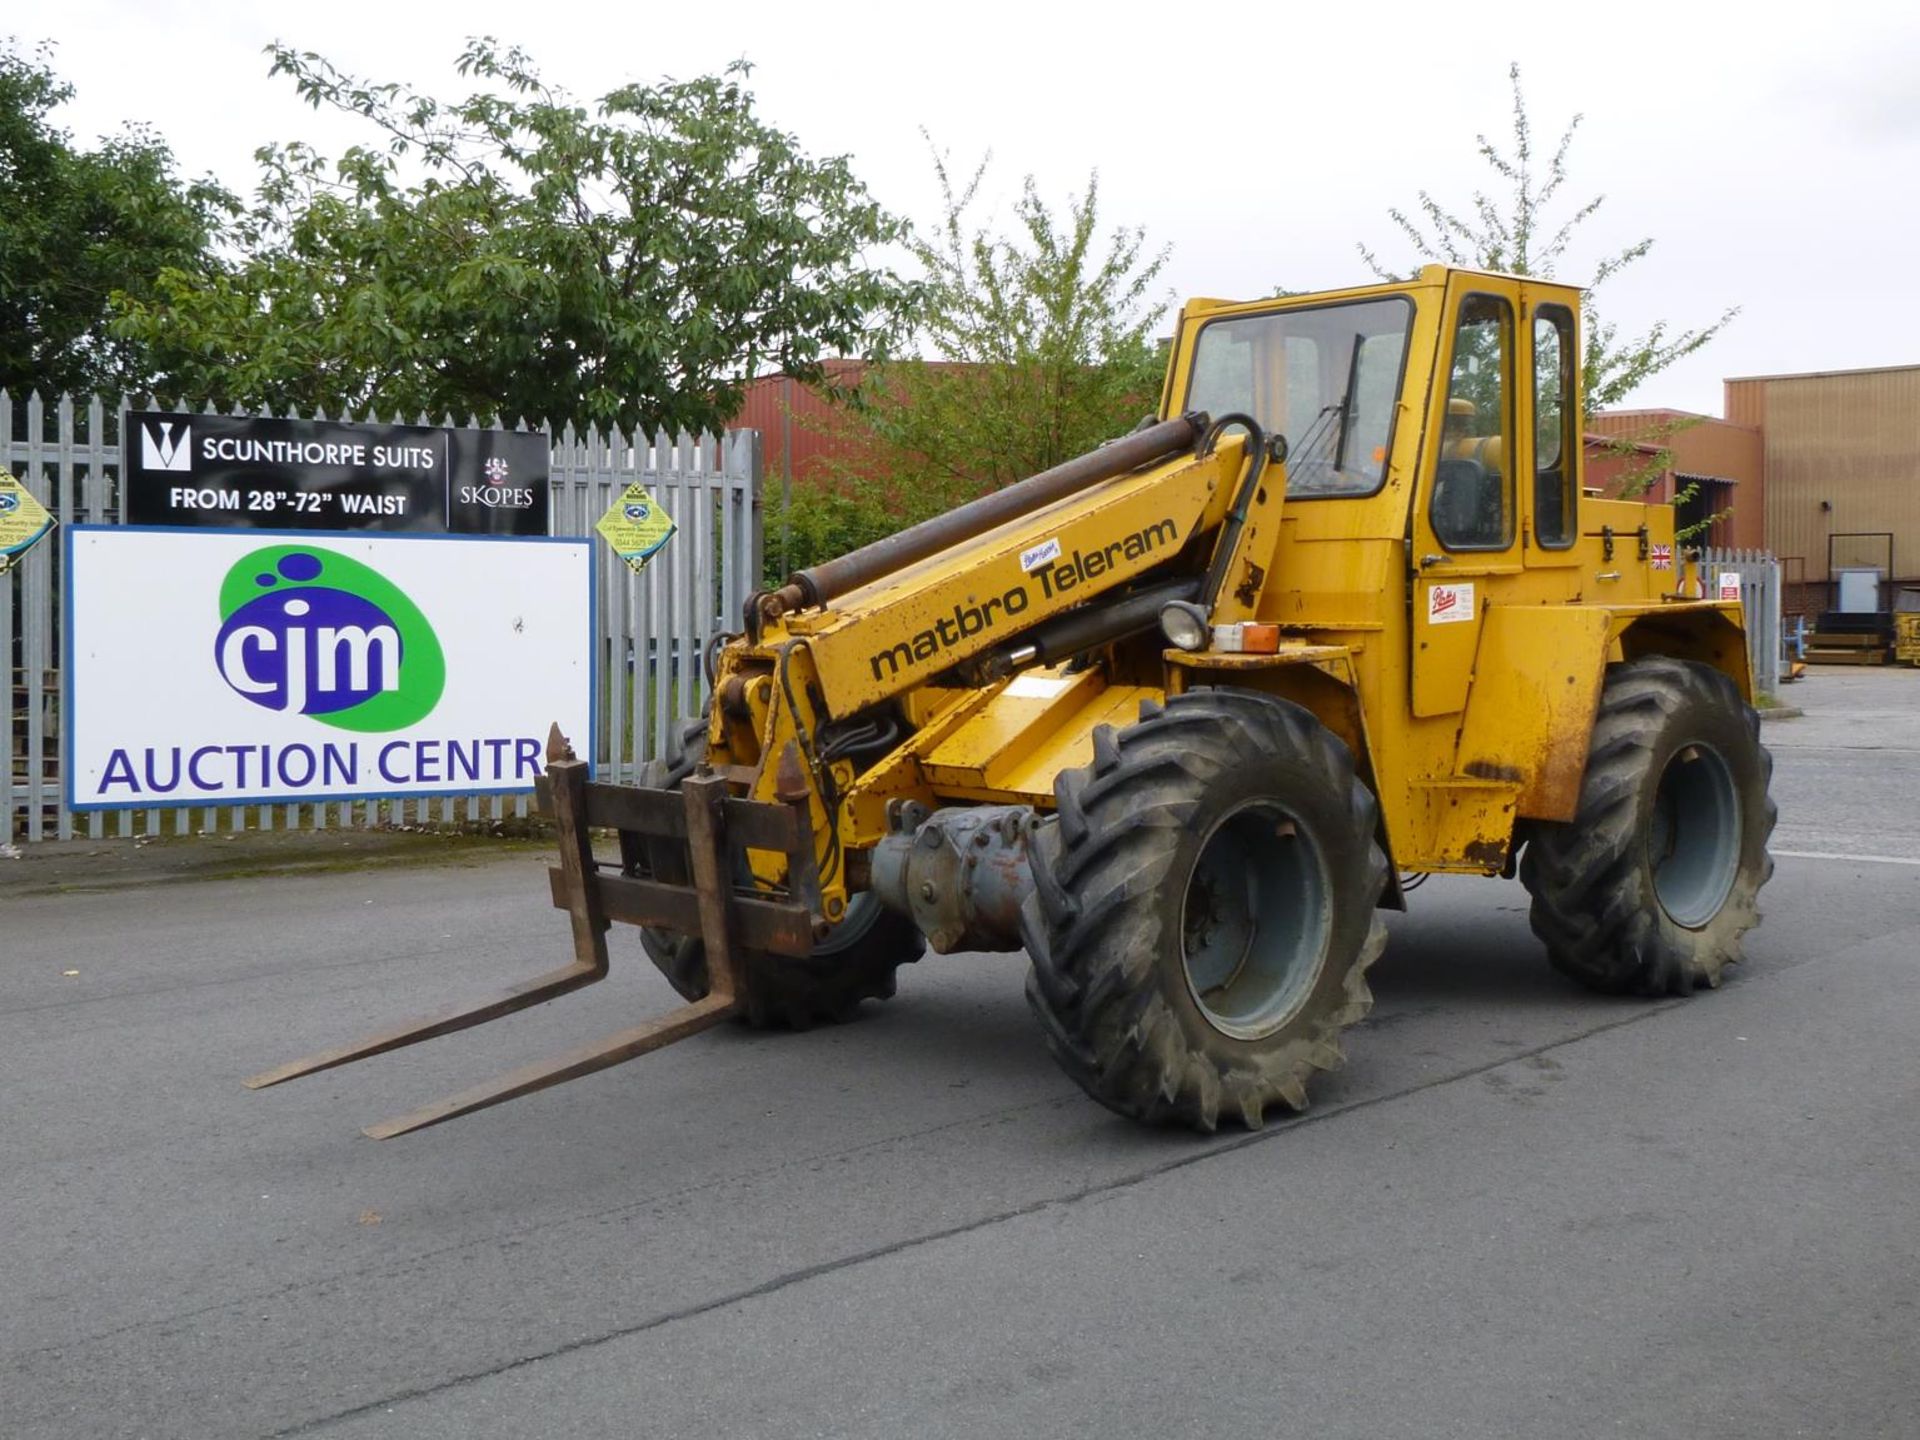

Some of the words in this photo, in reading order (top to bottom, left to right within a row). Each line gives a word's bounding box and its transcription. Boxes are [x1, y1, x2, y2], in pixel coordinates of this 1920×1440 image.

[202, 437, 366, 467] SCUNTHORPE
[372, 445, 434, 470] SUITS
[170, 487, 241, 511] FROM
[340, 493, 406, 515] WAIST
[459, 484, 534, 508] SKOPES
[869, 584, 1029, 682] matbro
[1030, 517, 1178, 600] Teleram
[222, 598, 400, 715] cjm
[96, 742, 358, 794] AUCTION
[377, 737, 570, 783] CENTR
